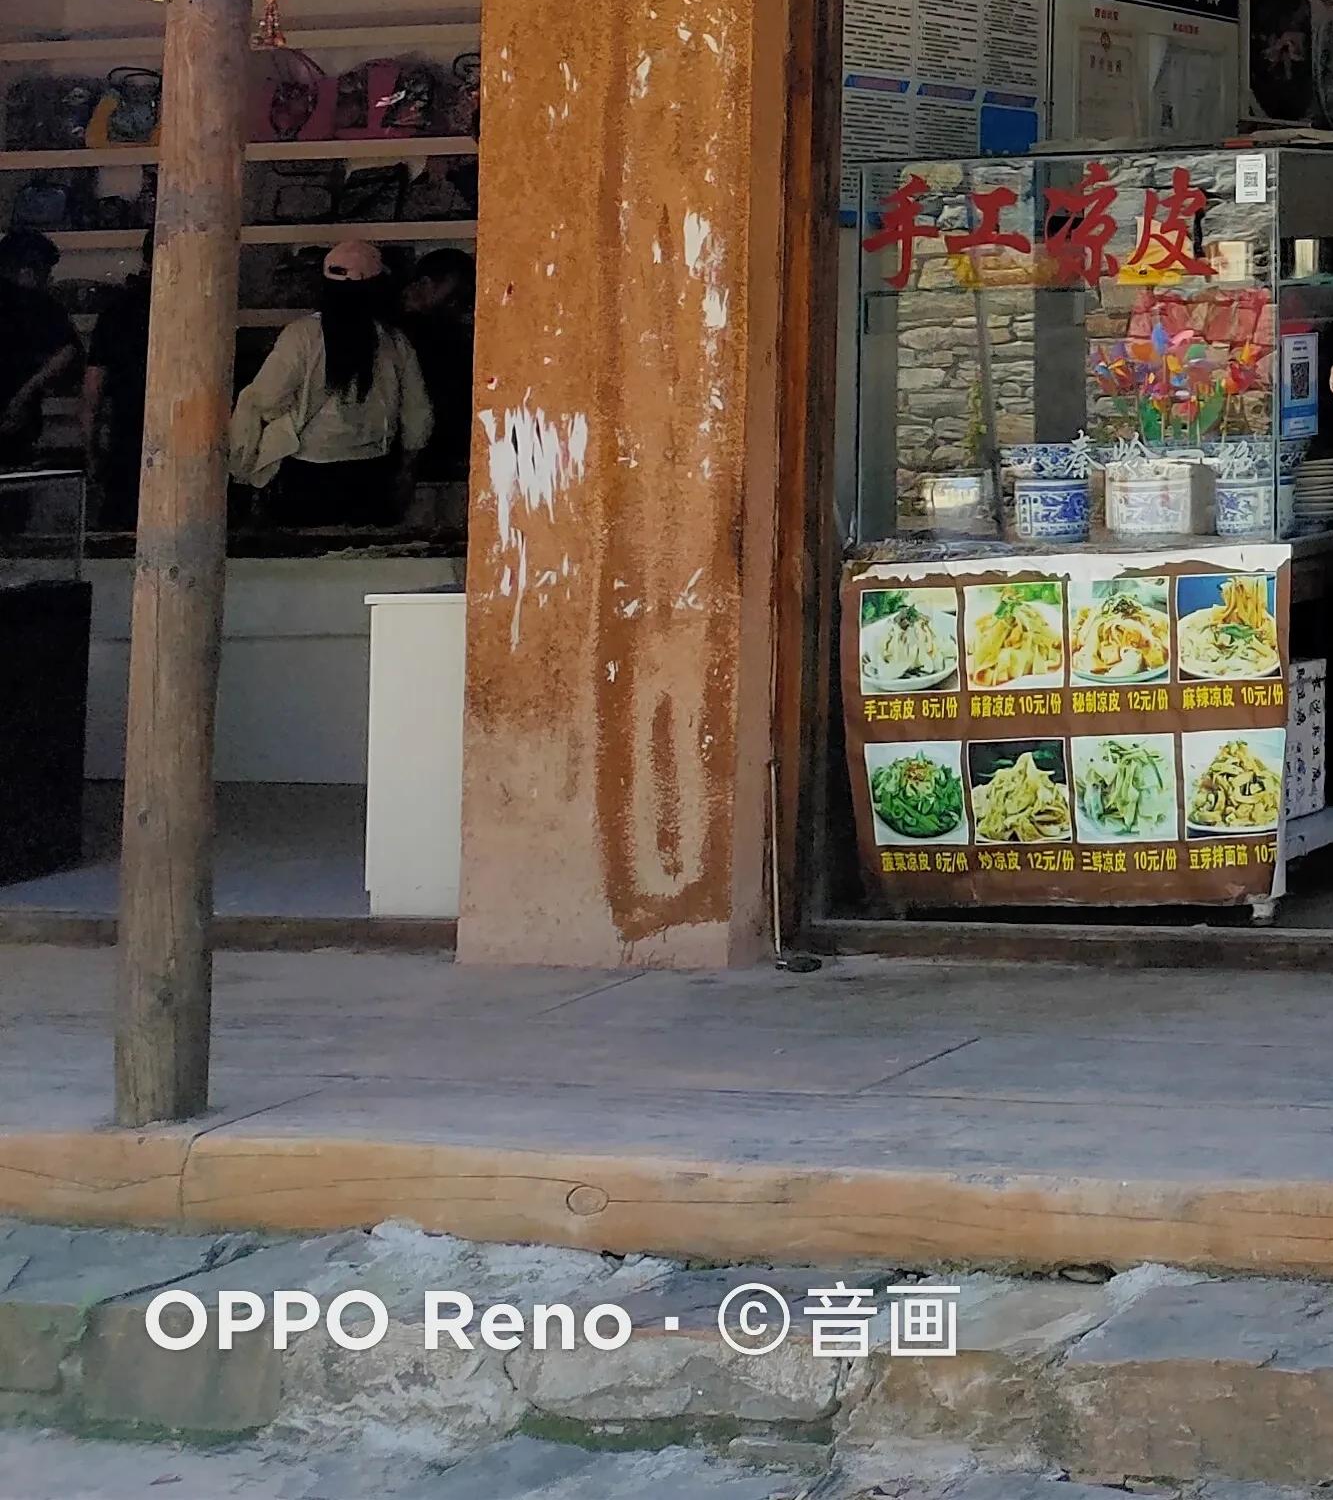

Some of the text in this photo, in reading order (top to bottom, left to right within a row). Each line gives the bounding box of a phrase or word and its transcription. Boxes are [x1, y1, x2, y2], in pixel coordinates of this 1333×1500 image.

[862, 161, 1219, 289] 手工凉皮
[863, 696, 958, 721] 手工凉皮 8元/份
[970, 693, 1062, 718] 麻酱凉皮 10元/份
[1072, 689, 1169, 713] 秘制凉皮 12元/份
[1182, 684, 1284, 710] 麻辣凉皮 10元/份
[935, 851, 969, 873] 8元/份
[978, 850, 1075, 871] 炒凉皮 12元/份
[1134, 848, 1177, 871] 10元/份
